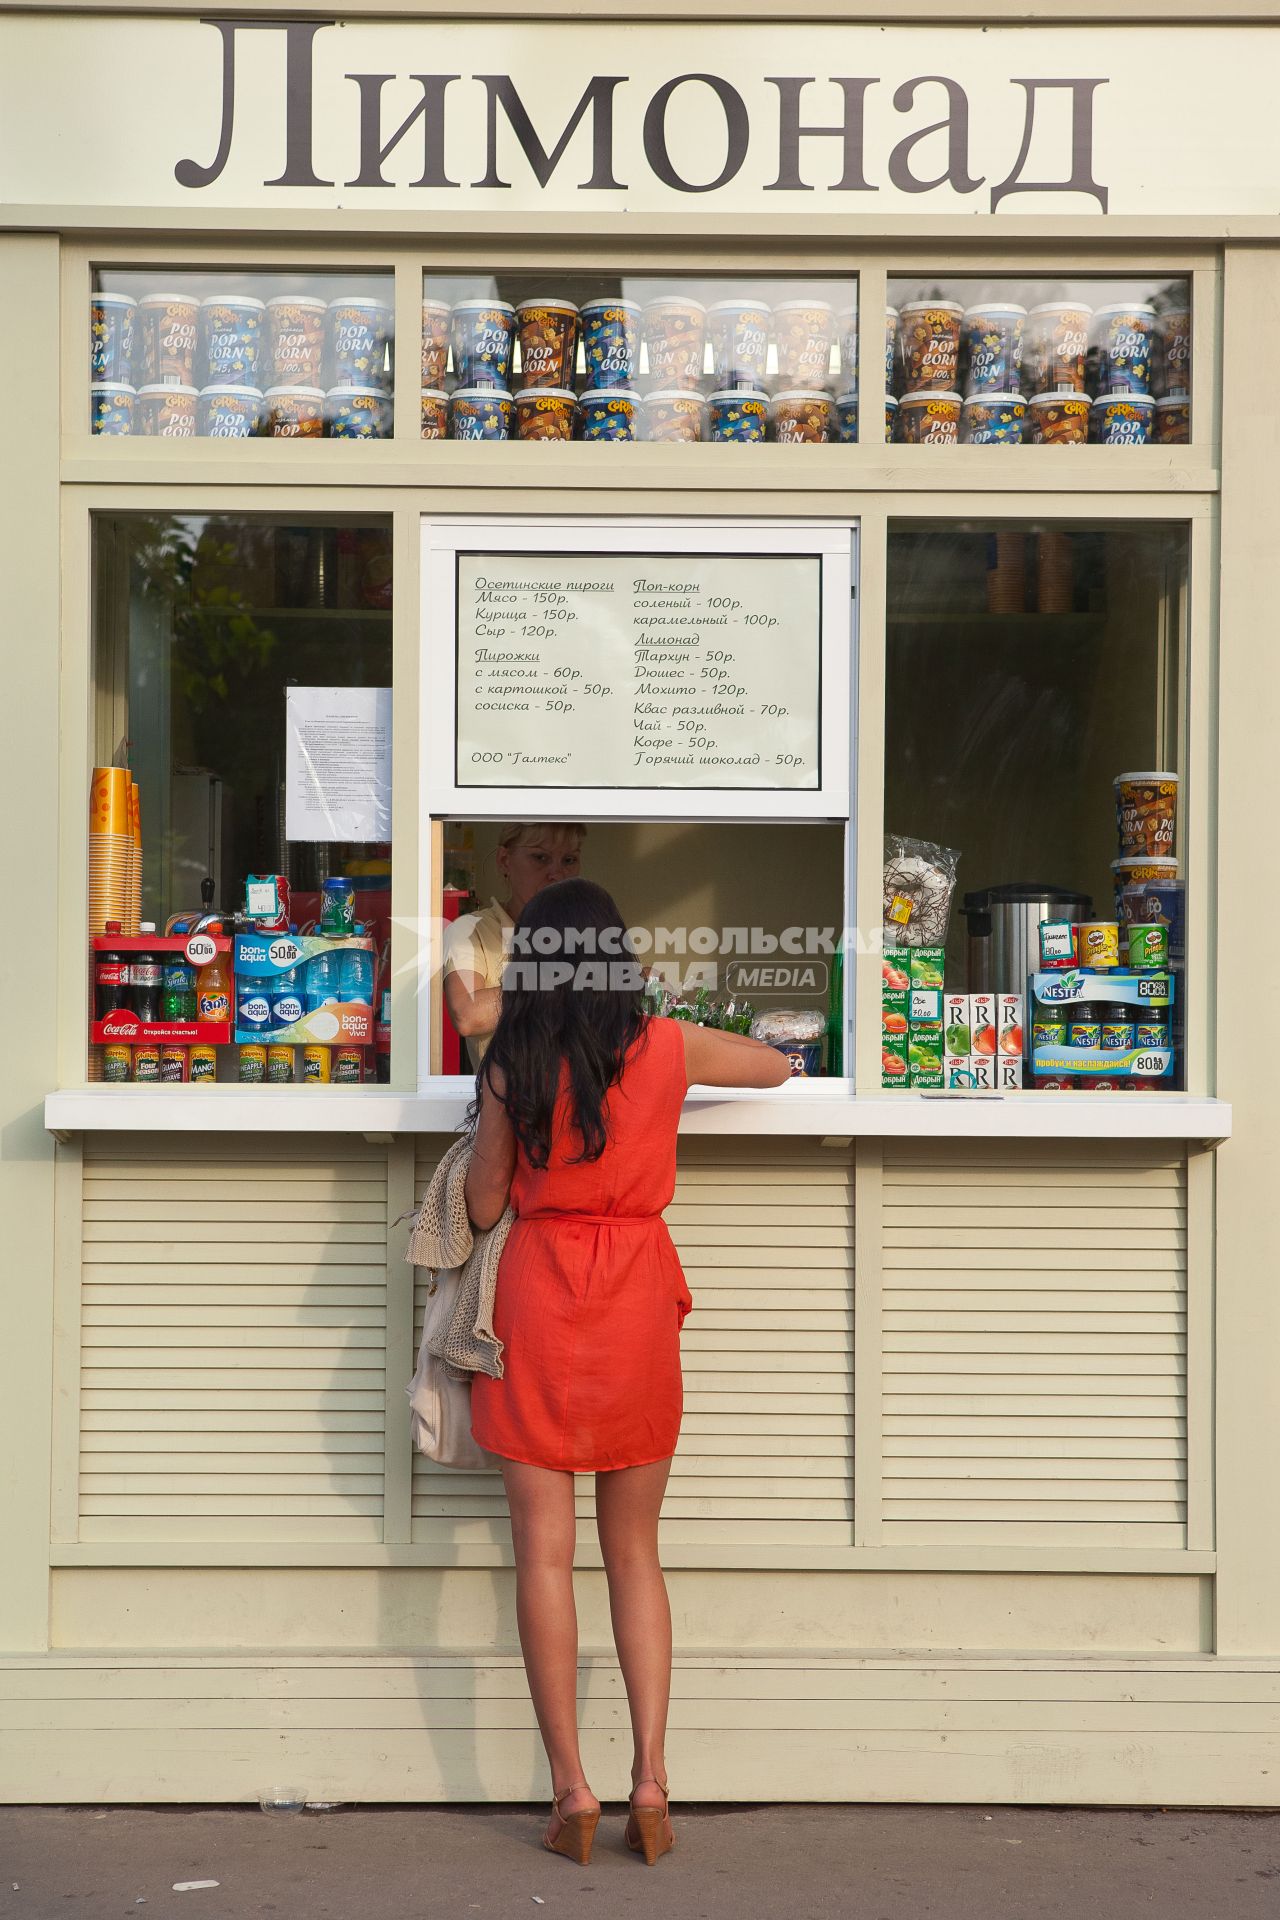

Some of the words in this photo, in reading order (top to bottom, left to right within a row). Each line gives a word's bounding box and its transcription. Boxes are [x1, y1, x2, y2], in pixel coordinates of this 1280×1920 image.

[174, 19, 1110, 216] Лимонад
[169, 323, 197, 336] POP
[340, 325, 369, 339] POP
[482, 329, 509, 342] POP
[211, 334, 238, 346] POP
[279, 335, 307, 347] POP
[335, 339, 374, 354] CORN
[928, 340, 955, 353] POP
[1116, 333, 1146, 346] POP
[208, 347, 244, 361] CORN
[274, 347, 313, 361] CORN
[526, 347, 553, 361] POP
[607, 346, 634, 361] POP
[800, 352, 826, 365] COR
[922, 353, 959, 367] CORN
[971, 352, 995, 367] POP
[1110, 346, 1150, 360] CORN
[523, 360, 559, 374] CORN
[601, 359, 635, 373] CORN
[215, 414, 245, 426] POP
[777, 420, 798, 432] OP
[209, 427, 251, 438] CORN
[274, 425, 300, 437] POP
[421, 427, 440, 439] OP
[931, 421, 957, 434] POP
[1111, 421, 1140, 435] POP
[1106, 434, 1146, 445] CORN
[474, 576, 562, 592] Осетинские
[563, 582, 615, 593] пироги
[632, 578, 701, 595] Поп-корн
[474, 591, 518, 604] Мясо
[533, 592, 569, 606] 150р.
[633, 597, 692, 609] соленый
[706, 597, 743, 612] 100р.
[475, 607, 528, 623] Курица
[543, 608, 579, 623] 150р.
[632, 614, 729, 628] карамельный
[743, 614, 780, 629] 100р.
[474, 623, 506, 639] Сыр
[520, 625, 557, 640] 120р.
[633, 632, 700, 647] Лимонад
[474, 648, 541, 664] Пирожки
[633, 648, 690, 665] Тархун
[705, 650, 736, 665] 50р.
[487, 669, 538, 678] мясом
[553, 666, 583, 681] 60р.
[633, 665, 685, 678] Дюшес
[699, 667, 731, 681] 50р.
[487, 683, 568, 697] картошкой
[583, 683, 614, 698] 50р.
[633, 682, 697, 696] Мохито
[711, 683, 748, 698] 120р.
[474, 702, 530, 711] сосиска
[544, 700, 576, 714] 50р.
[633, 701, 668, 715] Квас
[671, 702, 745, 718] разливной
[760, 704, 790, 718] 70р.
[633, 718, 662, 731] Чай
[676, 720, 707, 734] 50р.
[633, 735, 673, 750] Кофе
[687, 736, 718, 751] 50р.
[471, 751, 504, 763] ООО
[633, 751, 695, 767] Горячий
[699, 752, 761, 765] шоколад
[775, 753, 806, 768] 50р.
[1123, 809, 1138, 821] OP
[240, 953, 267, 963] aqua
[914, 949, 942, 958] Добрый
[882, 992, 905, 1001] обрый
[1043, 986, 1085, 999] NESTEA
[950, 1006, 965, 1024] R
[975, 1005, 990, 1023] R
[1003, 1005, 1018, 1023] R
[143, 1029, 171, 1037] Откройся
[342, 1022, 368, 1031] aqua
[882, 1034, 904, 1042] обрый
[912, 1034, 940, 1043] Добрый
[1039, 1033, 1059, 1041] NESTEA
[1105, 1037, 1132, 1046] NESTEA
[191, 1063, 215, 1074] MANGO
[914, 1075, 941, 1084] Добрый
[975, 1067, 990, 1086] R
[1003, 1067, 1018, 1086] R
